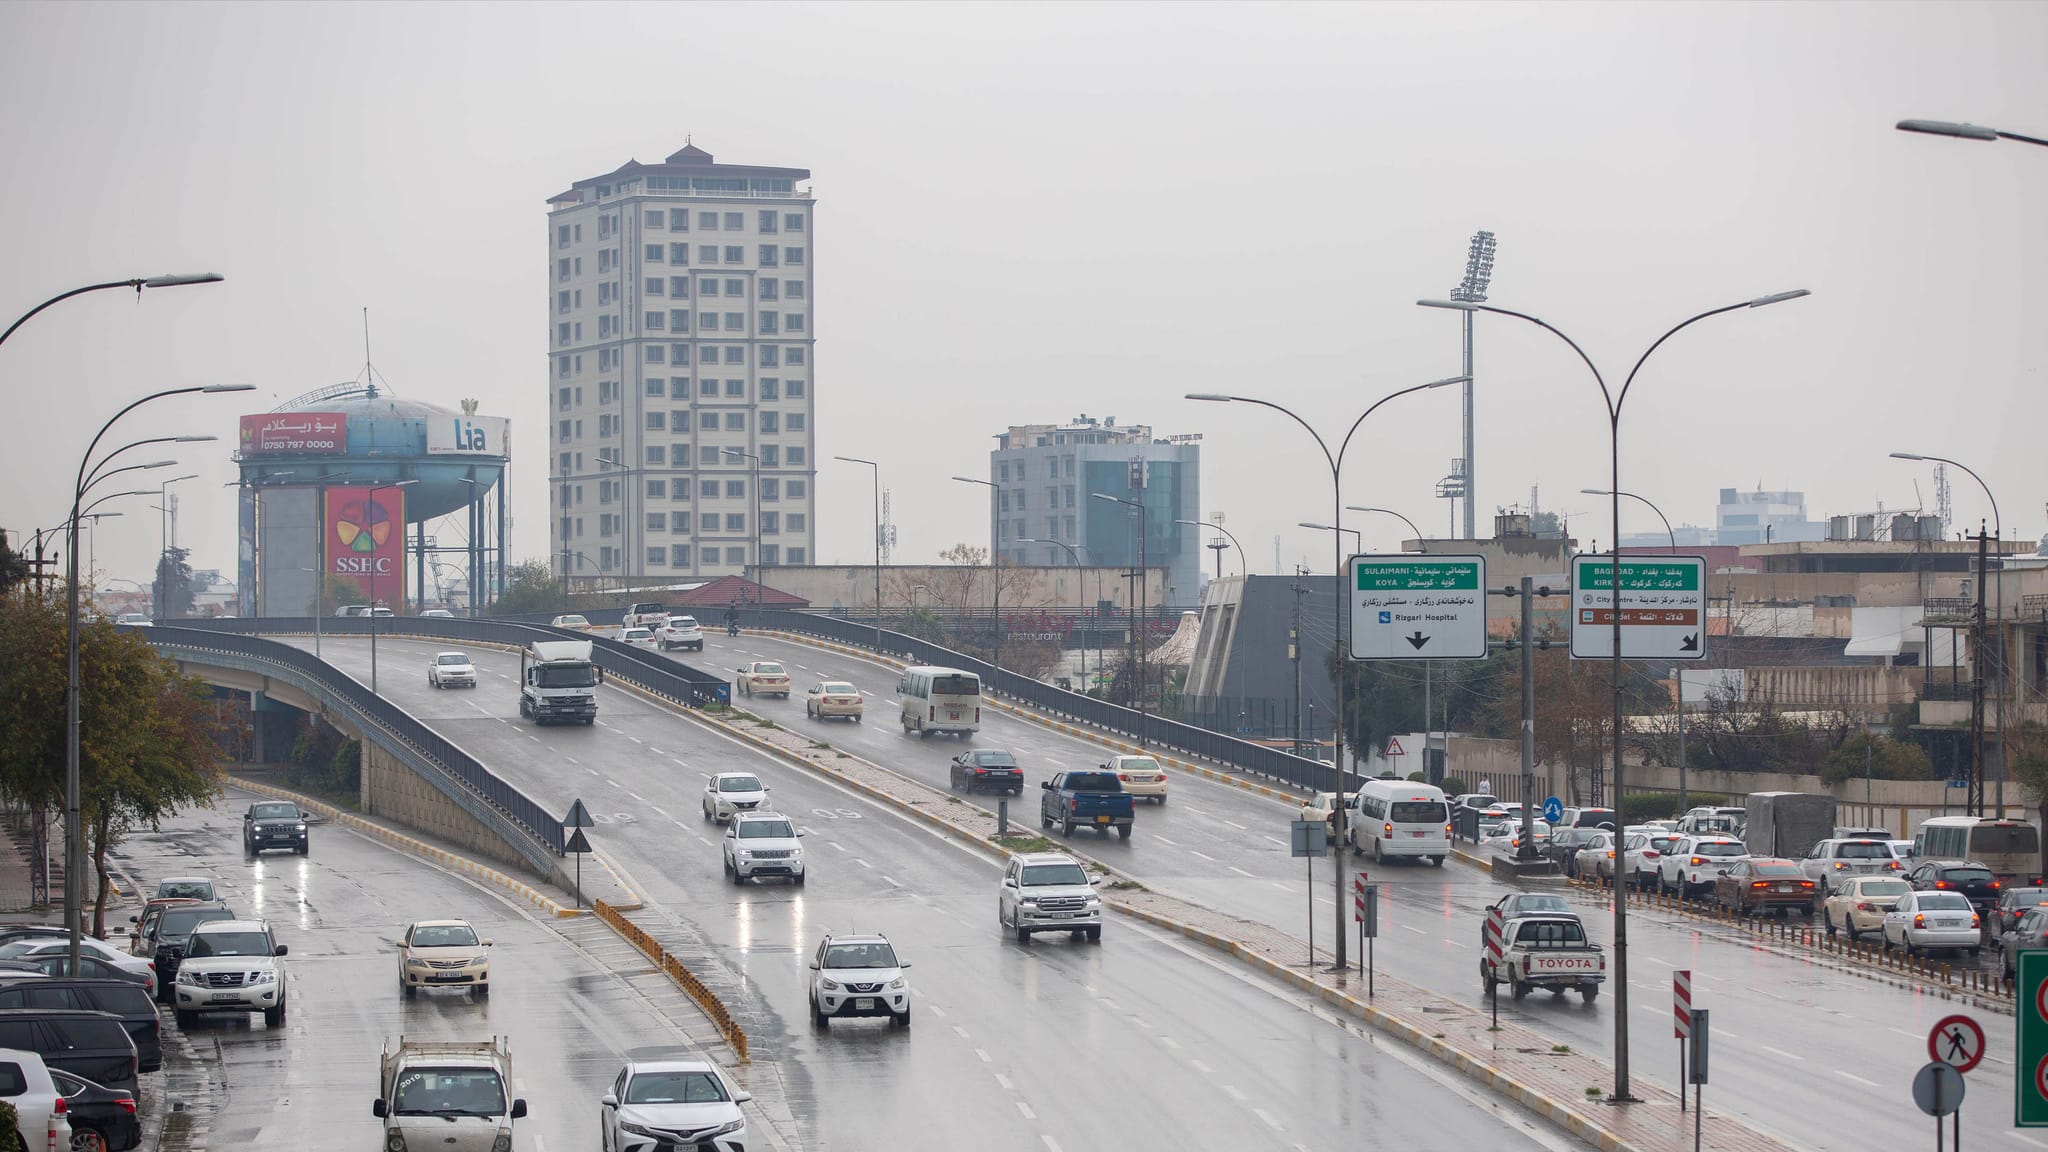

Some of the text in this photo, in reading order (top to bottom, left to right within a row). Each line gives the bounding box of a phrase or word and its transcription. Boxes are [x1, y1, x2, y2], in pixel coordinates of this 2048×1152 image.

[454, 418, 486, 451] Lia
[264, 441, 285, 450] 0750
[306, 440, 335, 449] 0000
[336, 557, 391, 573] SSHC
[1364, 567, 1410, 575] SULAIMANI
[1375, 579, 1398, 587] KOYA
[1596, 596, 1611, 604] City
[1395, 614, 1458, 623] Rizgari Hospital
[1538, 959, 1592, 968] TOYOTA
[400, 1073, 421, 1088] 2010
